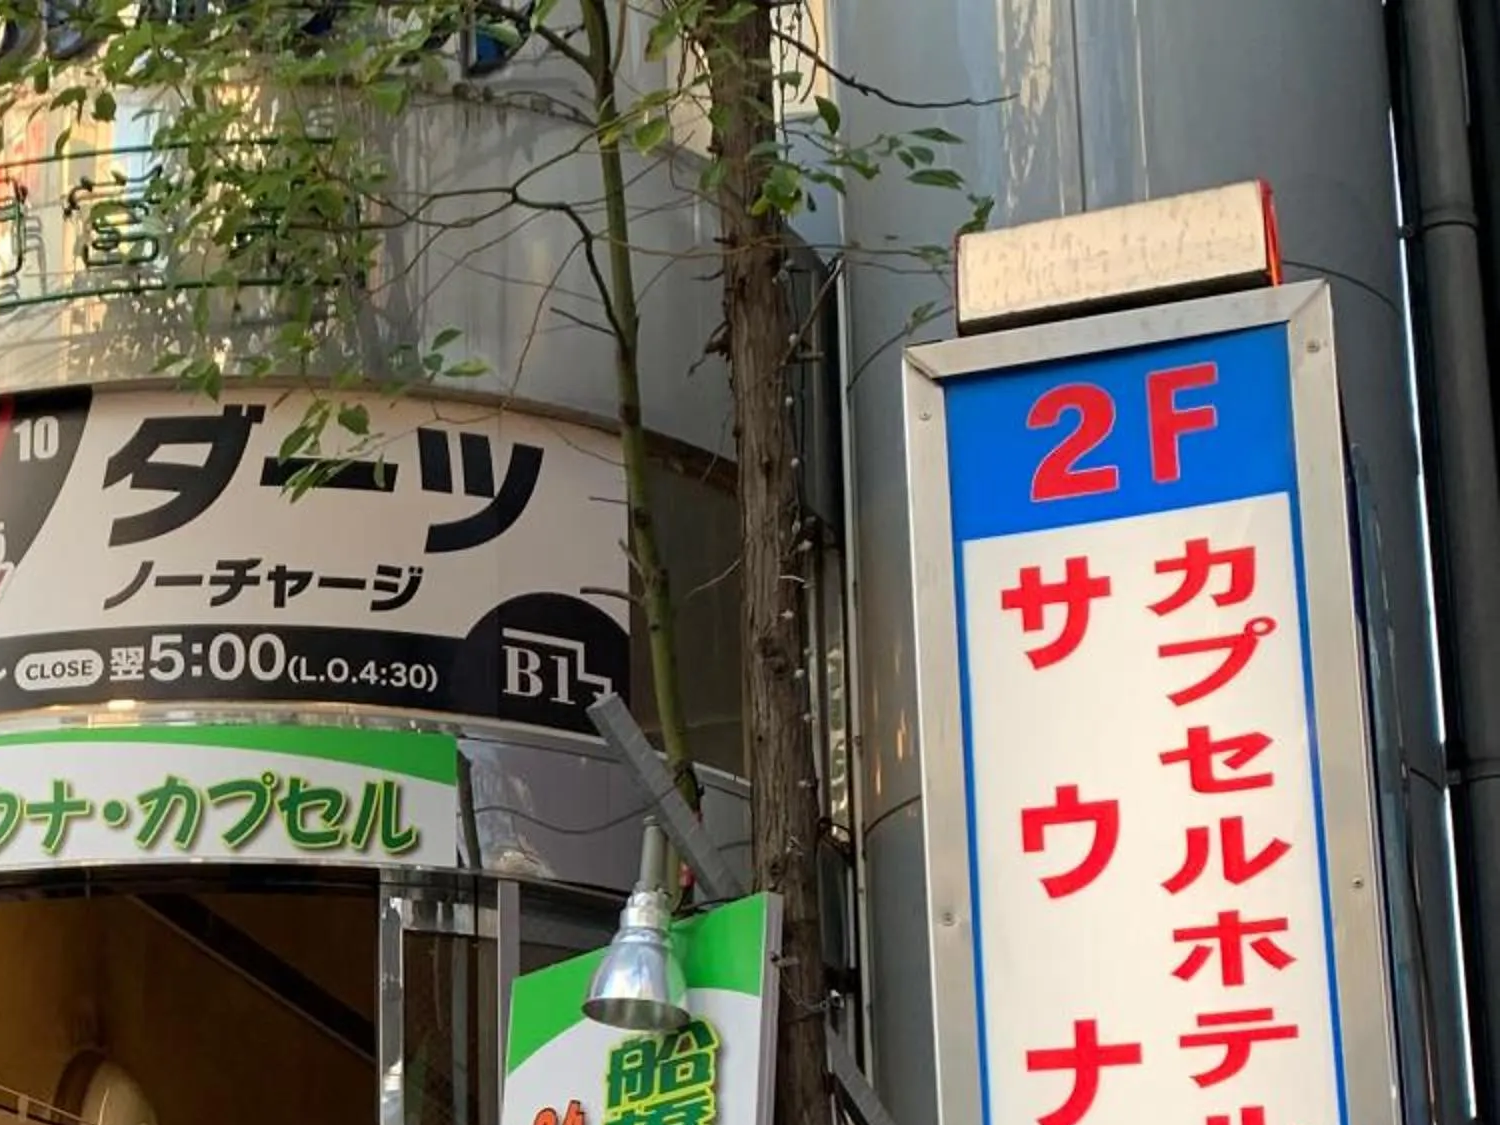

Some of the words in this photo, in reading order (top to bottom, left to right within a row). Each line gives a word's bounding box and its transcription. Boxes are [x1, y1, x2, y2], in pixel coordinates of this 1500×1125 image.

[14, 416, 60, 462] 10
[1026, 362, 1217, 502] 2F
[102, 403, 544, 553] ダーツ
[103, 558, 423, 611] ノーチャージ
[25, 659, 94, 680] CLOSE
[502, 645, 576, 705] B1
